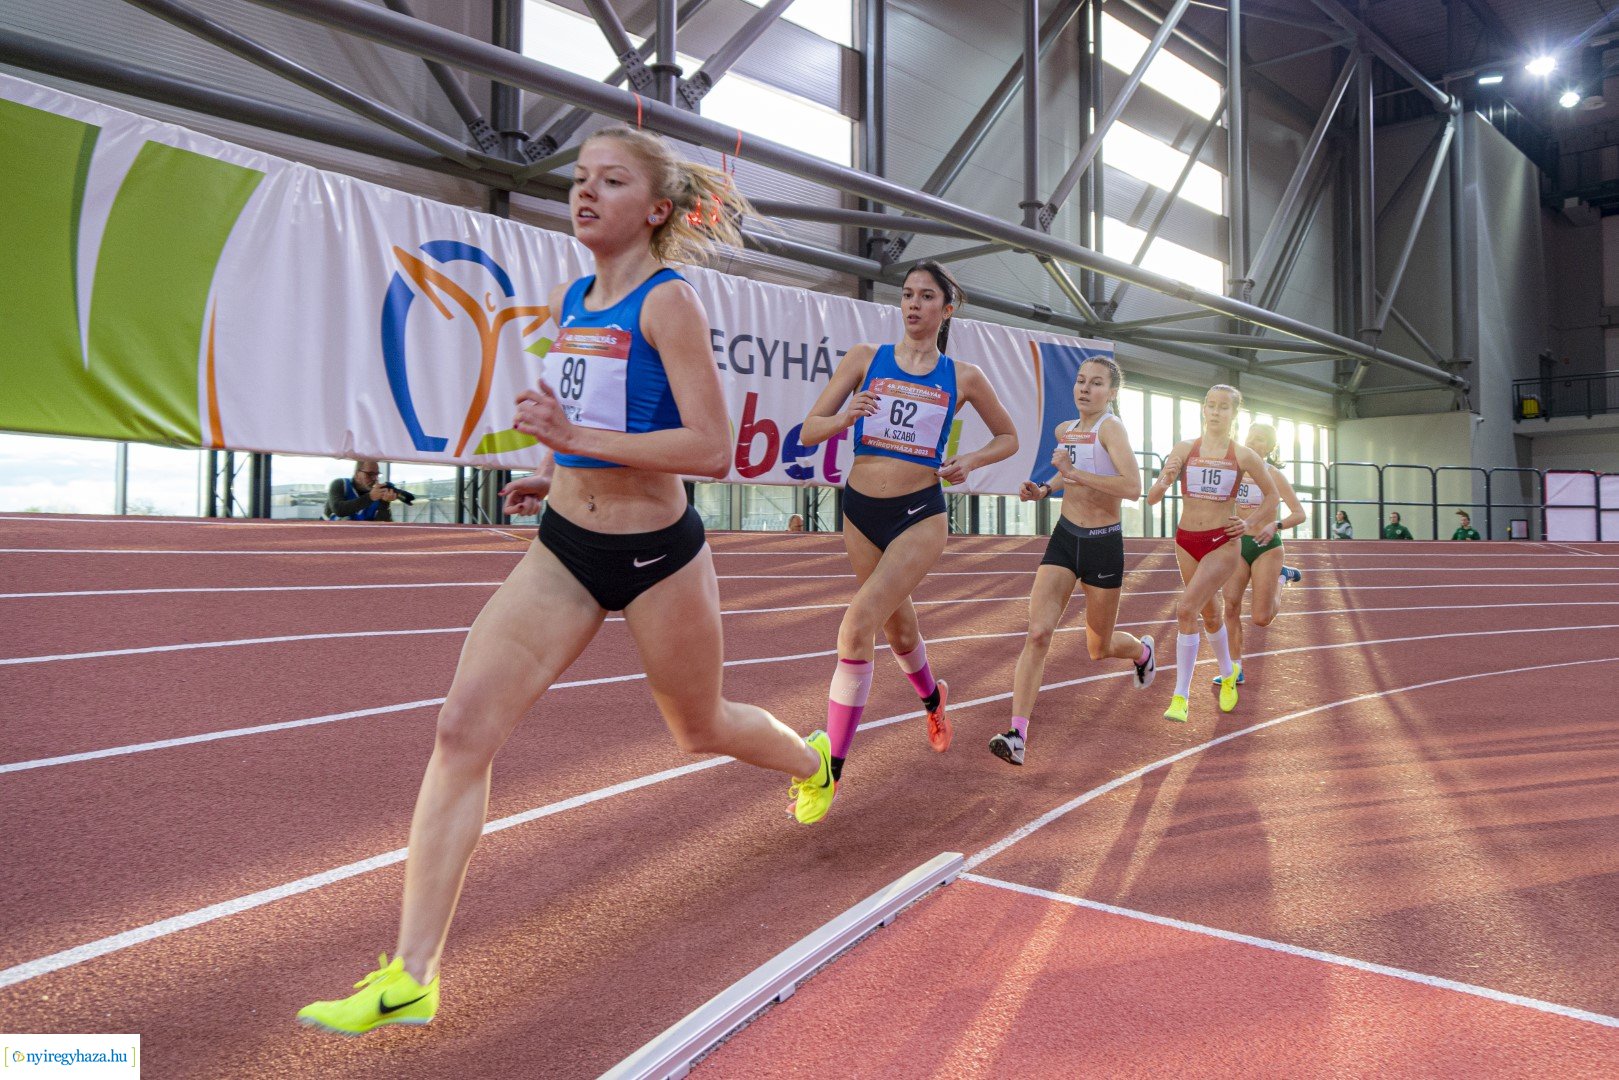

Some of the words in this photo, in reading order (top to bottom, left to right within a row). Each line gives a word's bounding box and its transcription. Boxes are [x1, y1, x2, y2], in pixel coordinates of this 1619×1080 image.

[710, 328, 848, 383] EGYHÁ
[561, 356, 586, 401] 89
[889, 399, 918, 429] 62
[884, 428, 891, 438] K.
[892, 429, 916, 443] SZABÓ
[867, 439, 913, 454] NYÍREGYHÁZA
[913, 448, 929, 456] 2023
[1201, 468, 1222, 486] 115
[1089, 528, 1108, 536] NIKE
[1108, 524, 1121, 533] PRO
